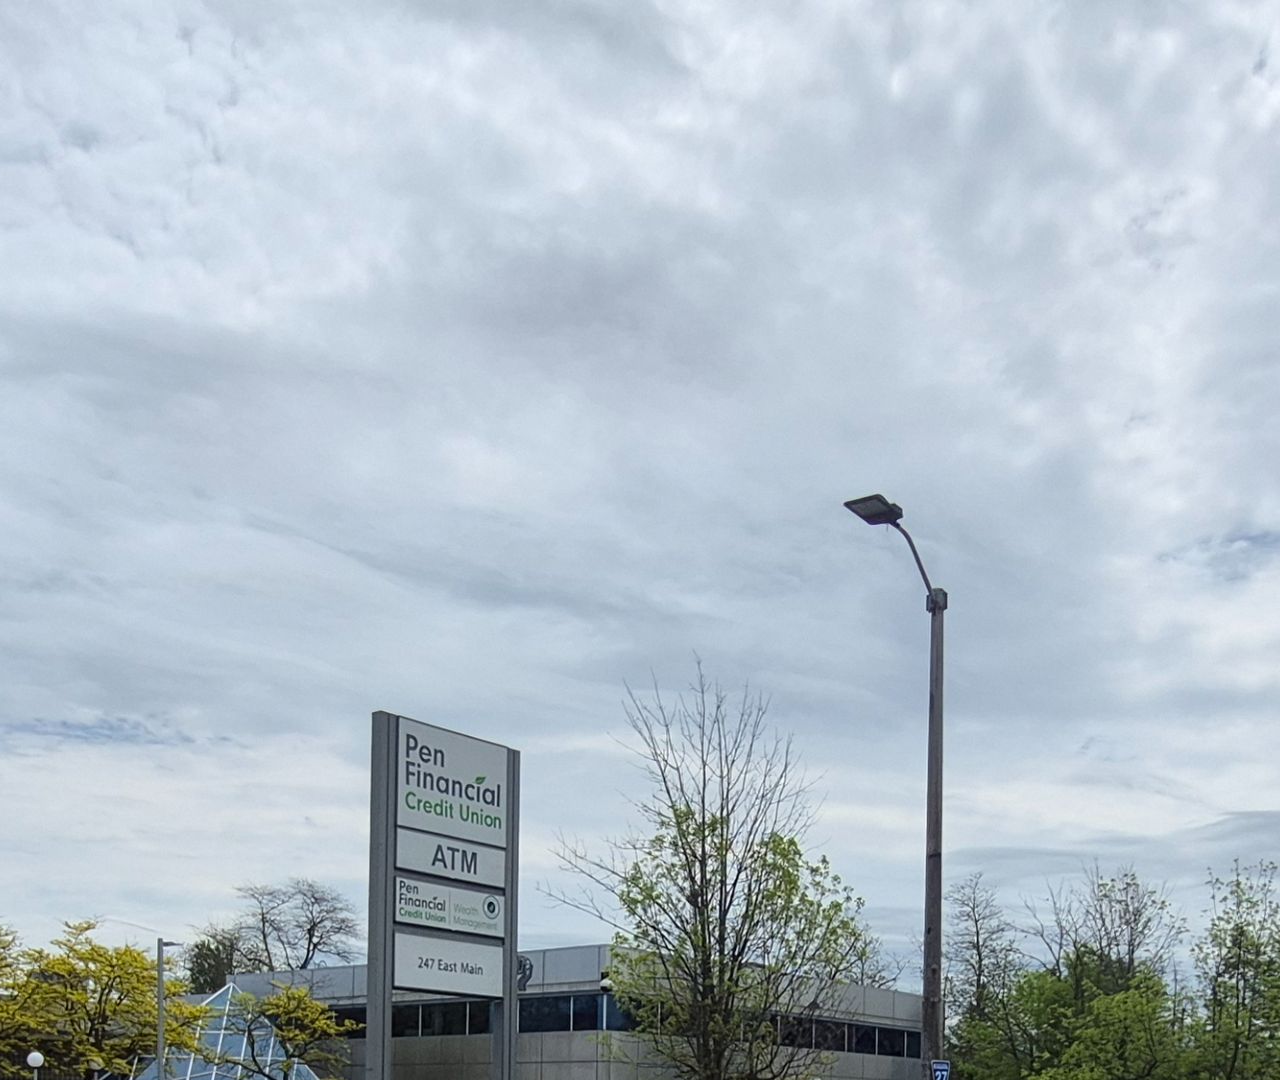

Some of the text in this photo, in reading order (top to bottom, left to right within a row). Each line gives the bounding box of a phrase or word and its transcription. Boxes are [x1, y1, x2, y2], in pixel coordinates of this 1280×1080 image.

[406, 733, 445, 767] Pen
[406, 760, 501, 807] Financial
[405, 791, 502, 830] Credit Union
[431, 844, 478, 875] ATM
[399, 880, 419, 895] Pen
[399, 892, 446, 912] Financial
[399, 907, 447, 923] Credit Union
[418, 956, 483, 975] 247 East Main
